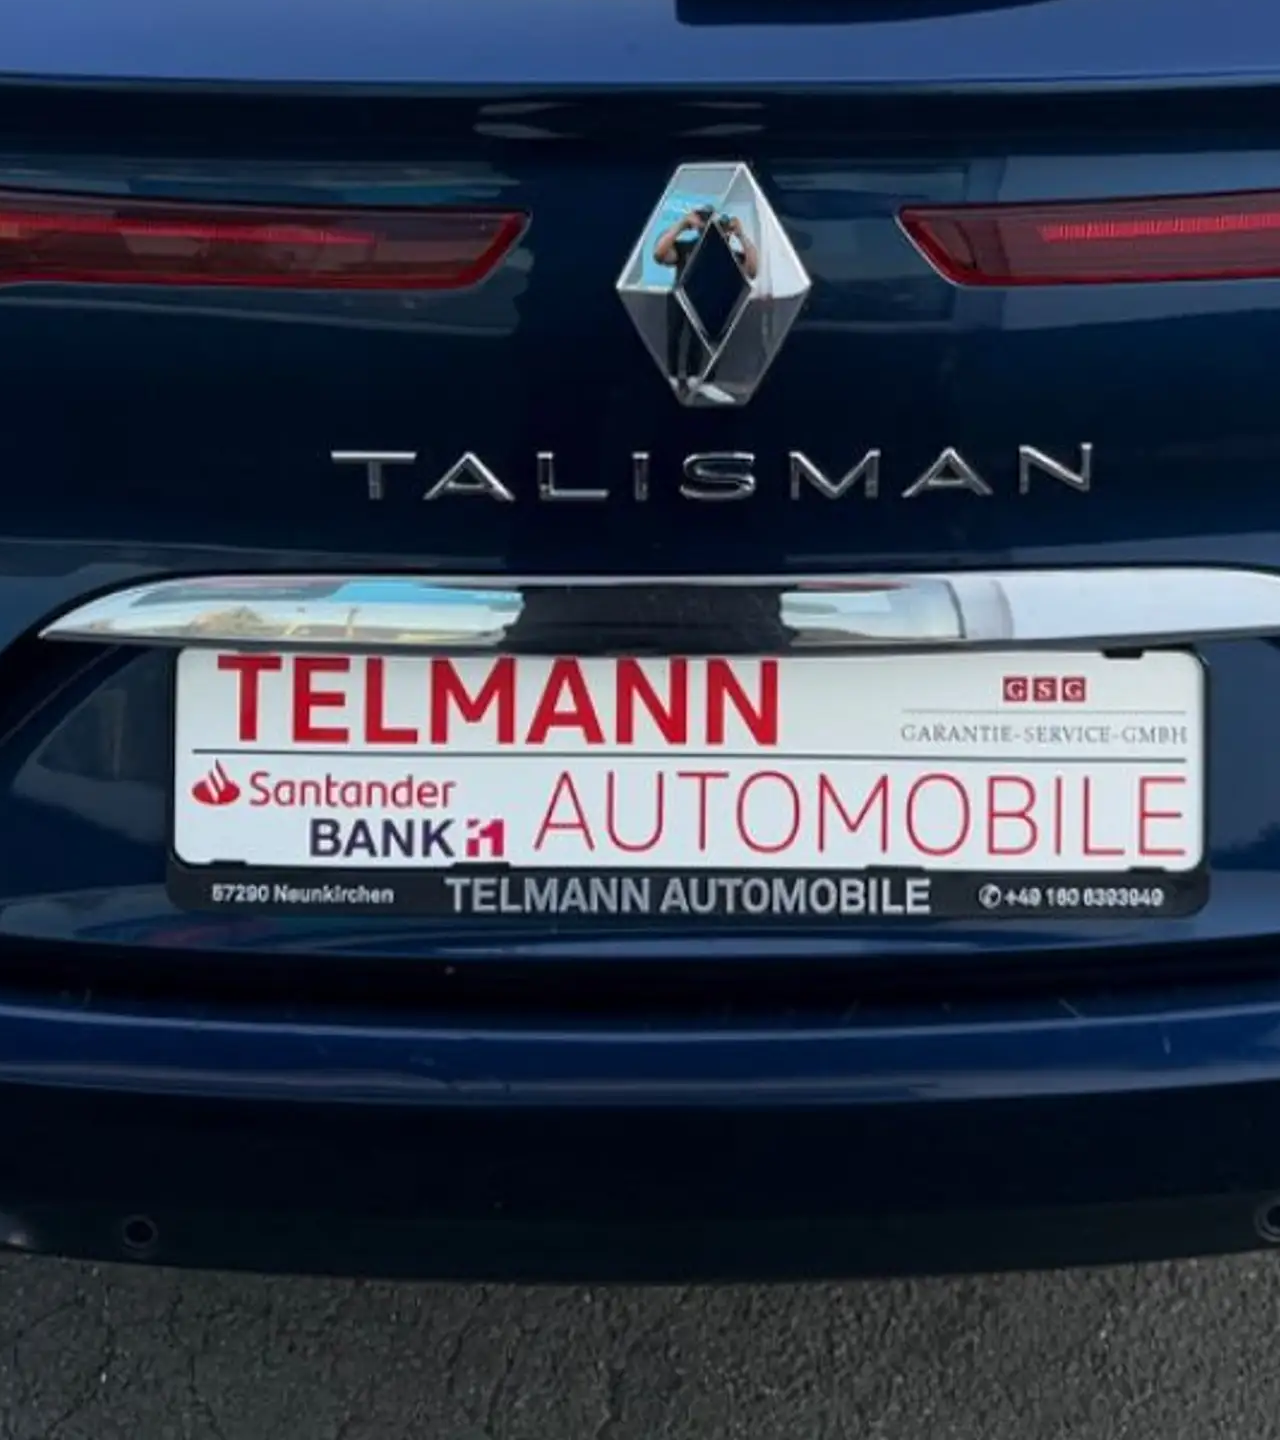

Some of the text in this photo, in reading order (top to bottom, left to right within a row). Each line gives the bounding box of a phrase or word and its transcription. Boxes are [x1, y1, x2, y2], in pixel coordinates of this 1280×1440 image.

[331, 443, 1094, 501] TALISMAN
[217, 653, 778, 745] TELMANN
[1003, 677, 1086, 702] GSG
[900, 723, 1188, 745] GARANTIE-SERVICE-GMBH
[250, 770, 457, 808] Santander
[534, 771, 1187, 857] AUTOMOBILE
[309, 818, 455, 858] BANK
[274, 885, 395, 905] Neunkirchen
[445, 877, 931, 915] TELMANN AUTOMOBILE
